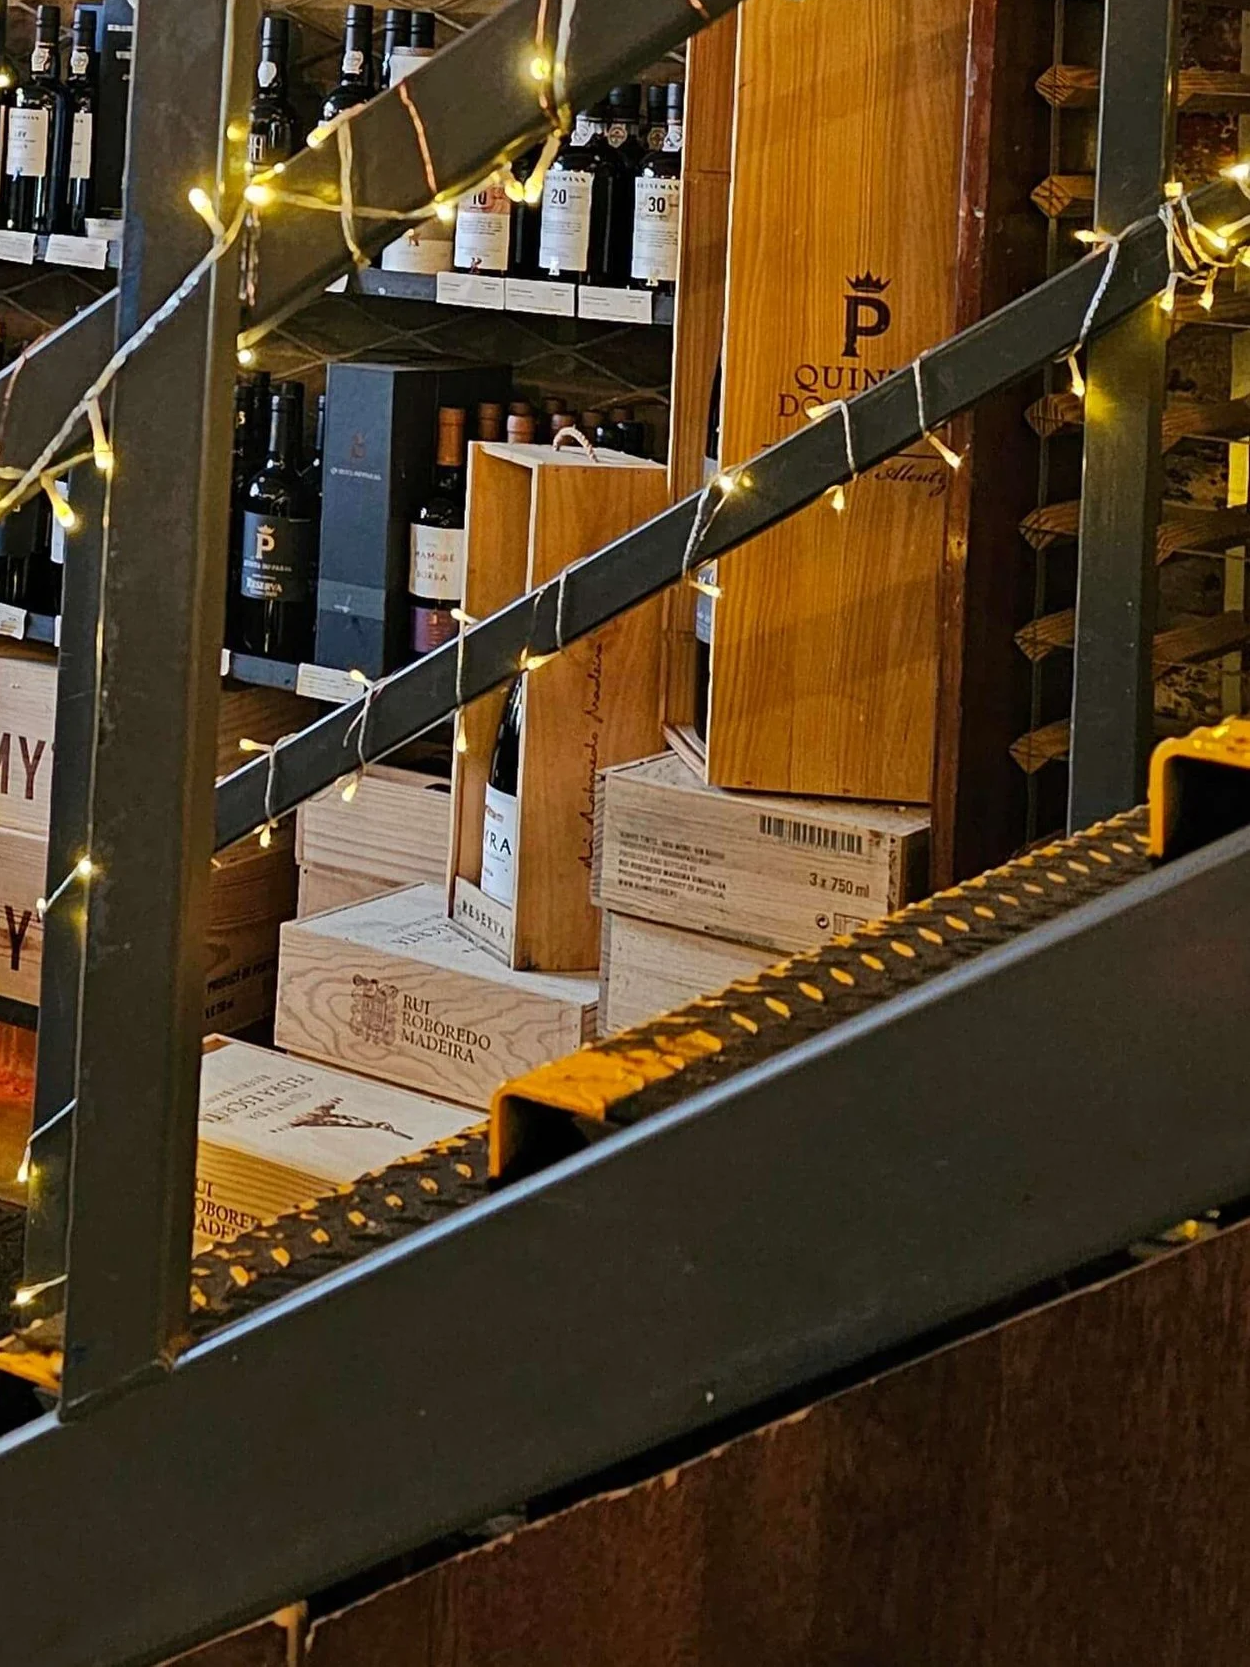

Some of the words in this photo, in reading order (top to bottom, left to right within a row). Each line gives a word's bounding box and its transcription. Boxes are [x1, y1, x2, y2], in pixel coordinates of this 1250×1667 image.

[551, 188, 567, 205] 20
[648, 196, 666, 214] 30
[841, 295, 891, 357] P
[794, 364, 897, 392] QUIN
[255, 533, 275, 559] P
[809, 872, 818, 887] 3
[820, 877, 827, 888] x
[831, 876, 853, 895] 750
[854, 881, 870, 898] ml
[462, 898, 506, 940] RESERVA
[402, 993, 431, 1016] RUI
[402, 1011, 492, 1052] ROBOREDO
[401, 1029, 476, 1066] MADEIRA
[195, 1180, 215, 1198] UI
